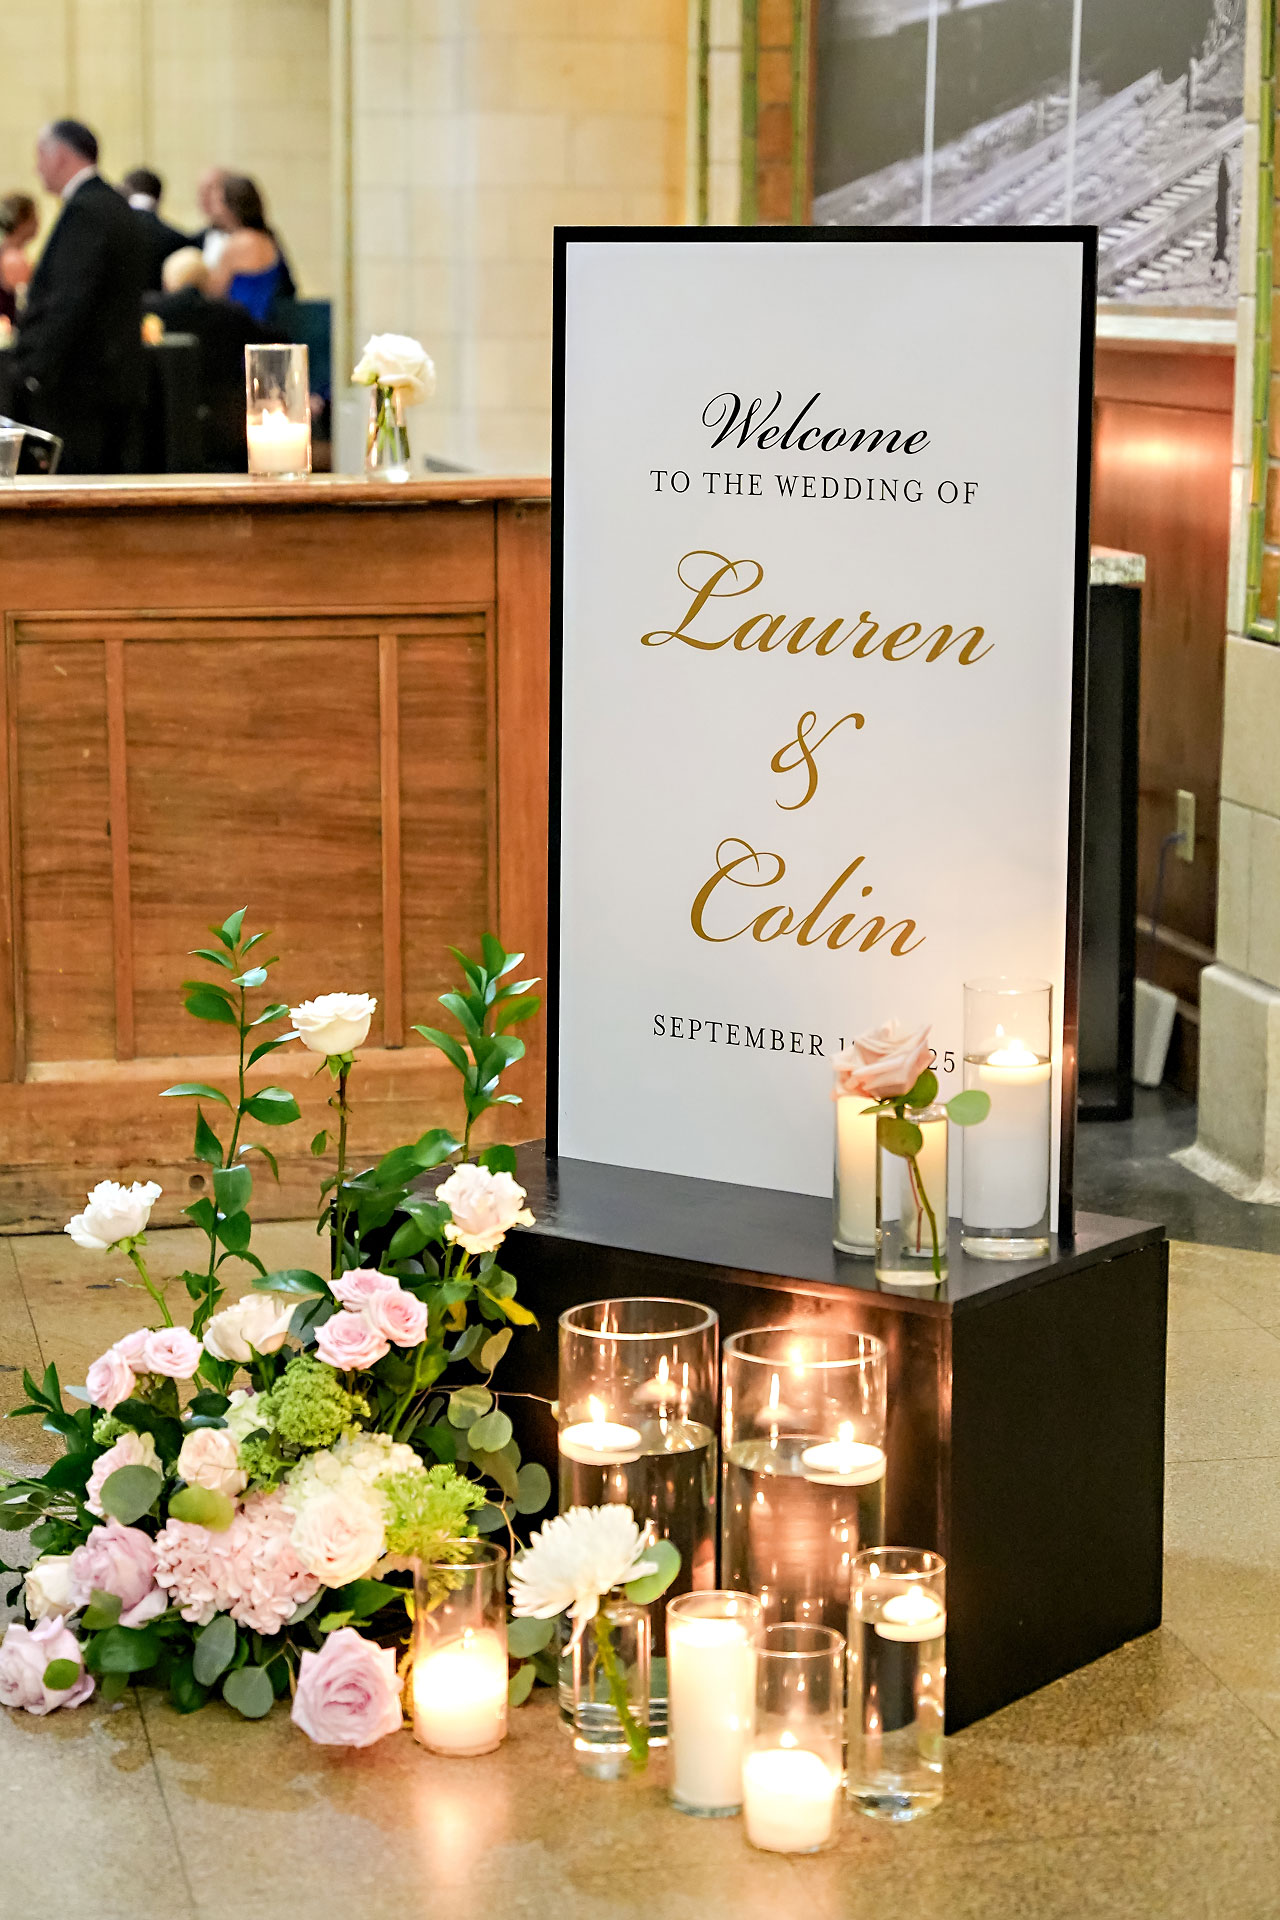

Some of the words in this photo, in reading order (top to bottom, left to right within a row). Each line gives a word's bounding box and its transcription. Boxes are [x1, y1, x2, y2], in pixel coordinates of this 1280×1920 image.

[702, 390, 931, 455] Welcome
[649, 470, 690, 494] TO
[703, 472, 763, 496] THE
[774, 474, 924, 503] WEDDING
[937, 480, 979, 505] OF
[640, 550, 995, 666] Lauren
[770, 710, 865, 811] &
[690, 837, 927, 957] Colin
[653, 1014, 825, 1057] SEPTEMBER
